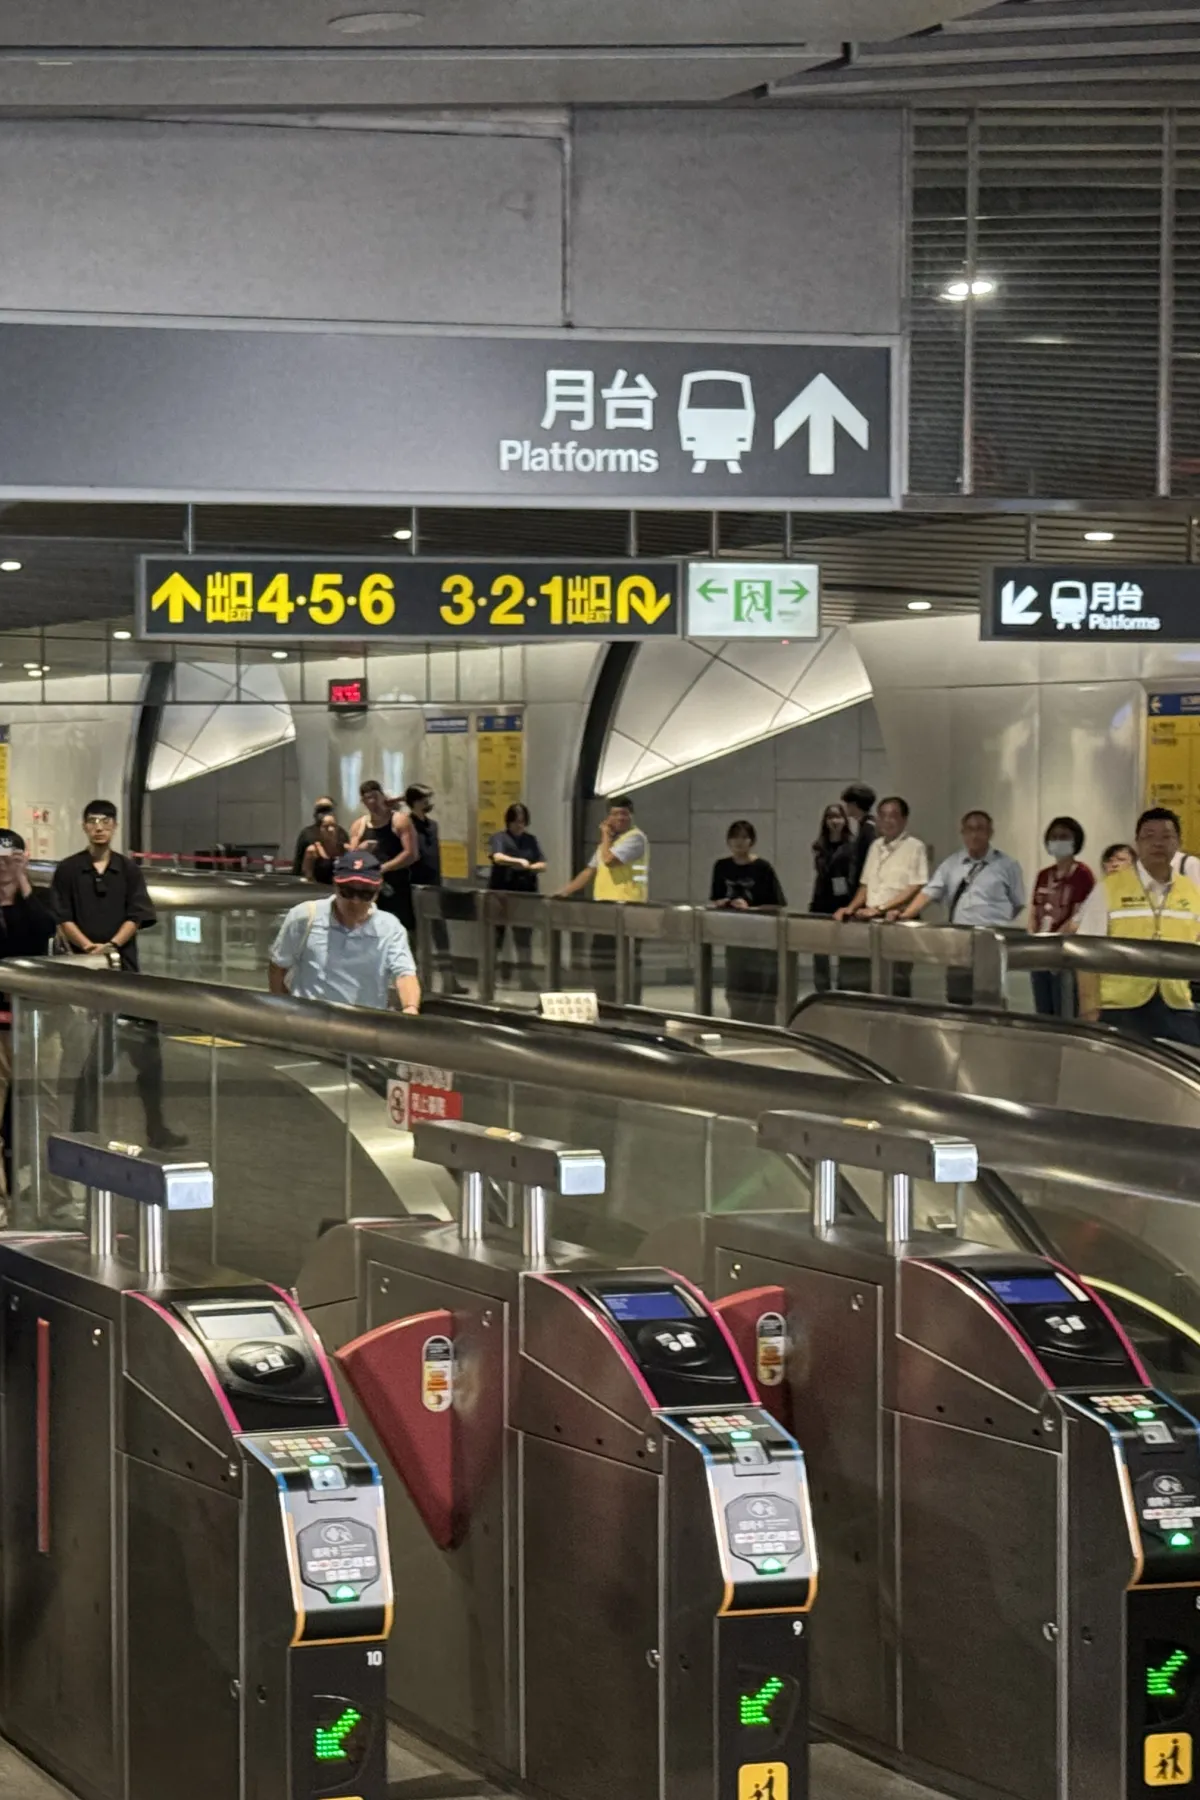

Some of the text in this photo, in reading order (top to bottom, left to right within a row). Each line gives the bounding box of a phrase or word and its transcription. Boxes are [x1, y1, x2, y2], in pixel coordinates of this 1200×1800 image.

[540, 368, 658, 431] 月台
[499, 439, 659, 473] Platforms
[1089, 581, 1144, 612] 月台
[1088, 613, 1161, 631] Platforms
[792, 1620, 803, 1636] 9
[366, 1650, 383, 1666] 10
